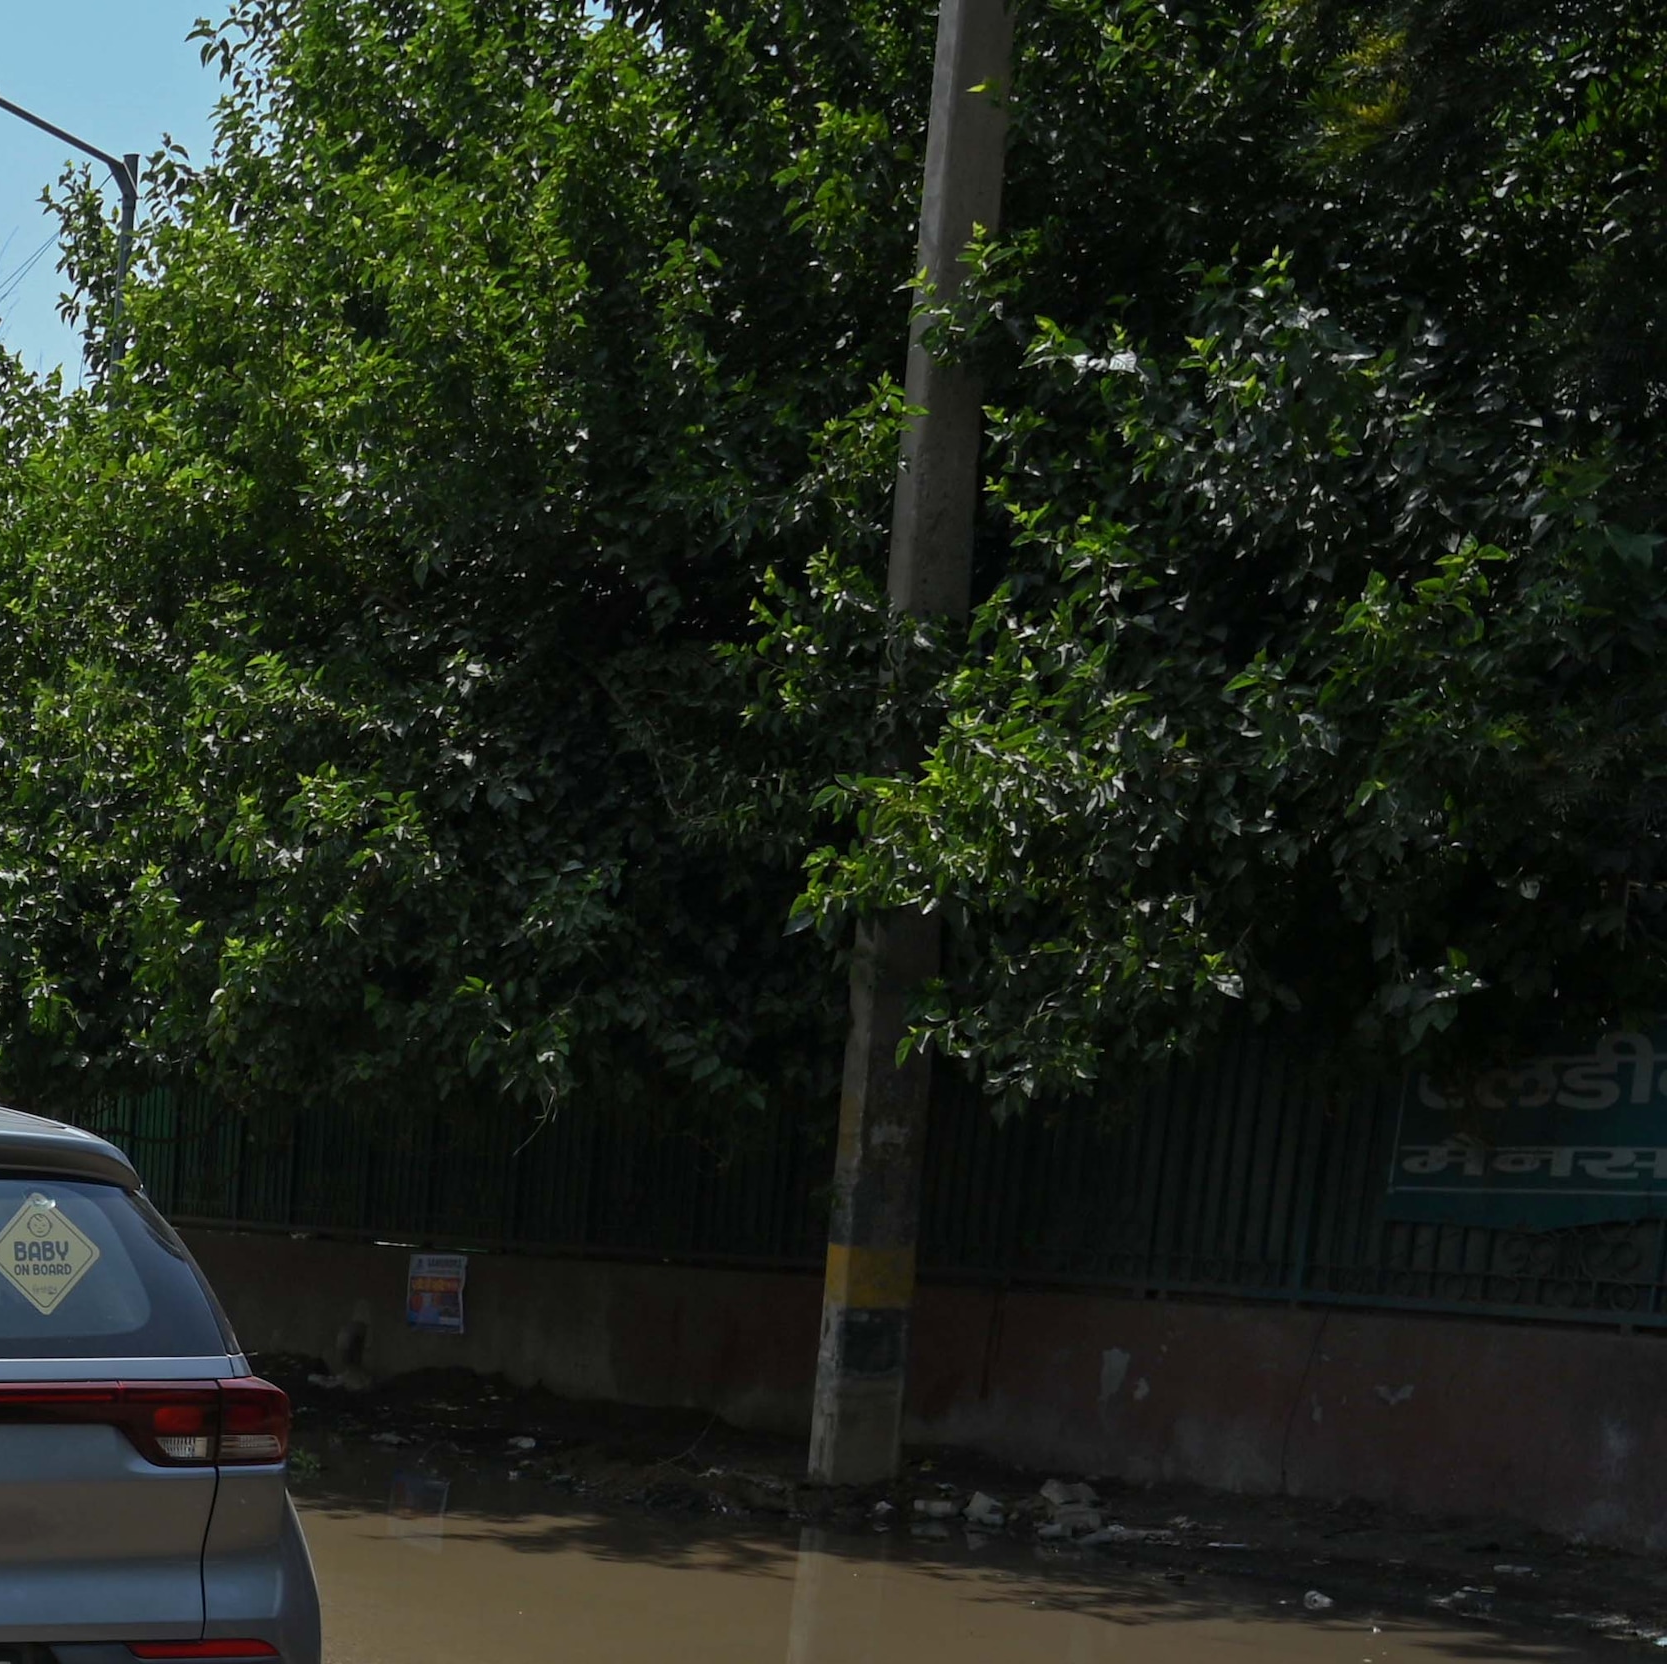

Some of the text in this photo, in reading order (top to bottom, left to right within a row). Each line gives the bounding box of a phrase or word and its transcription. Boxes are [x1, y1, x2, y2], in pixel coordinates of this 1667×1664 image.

[13, 1241, 69, 1261] BABY
[14, 1264, 72, 1276] ON BOARD
